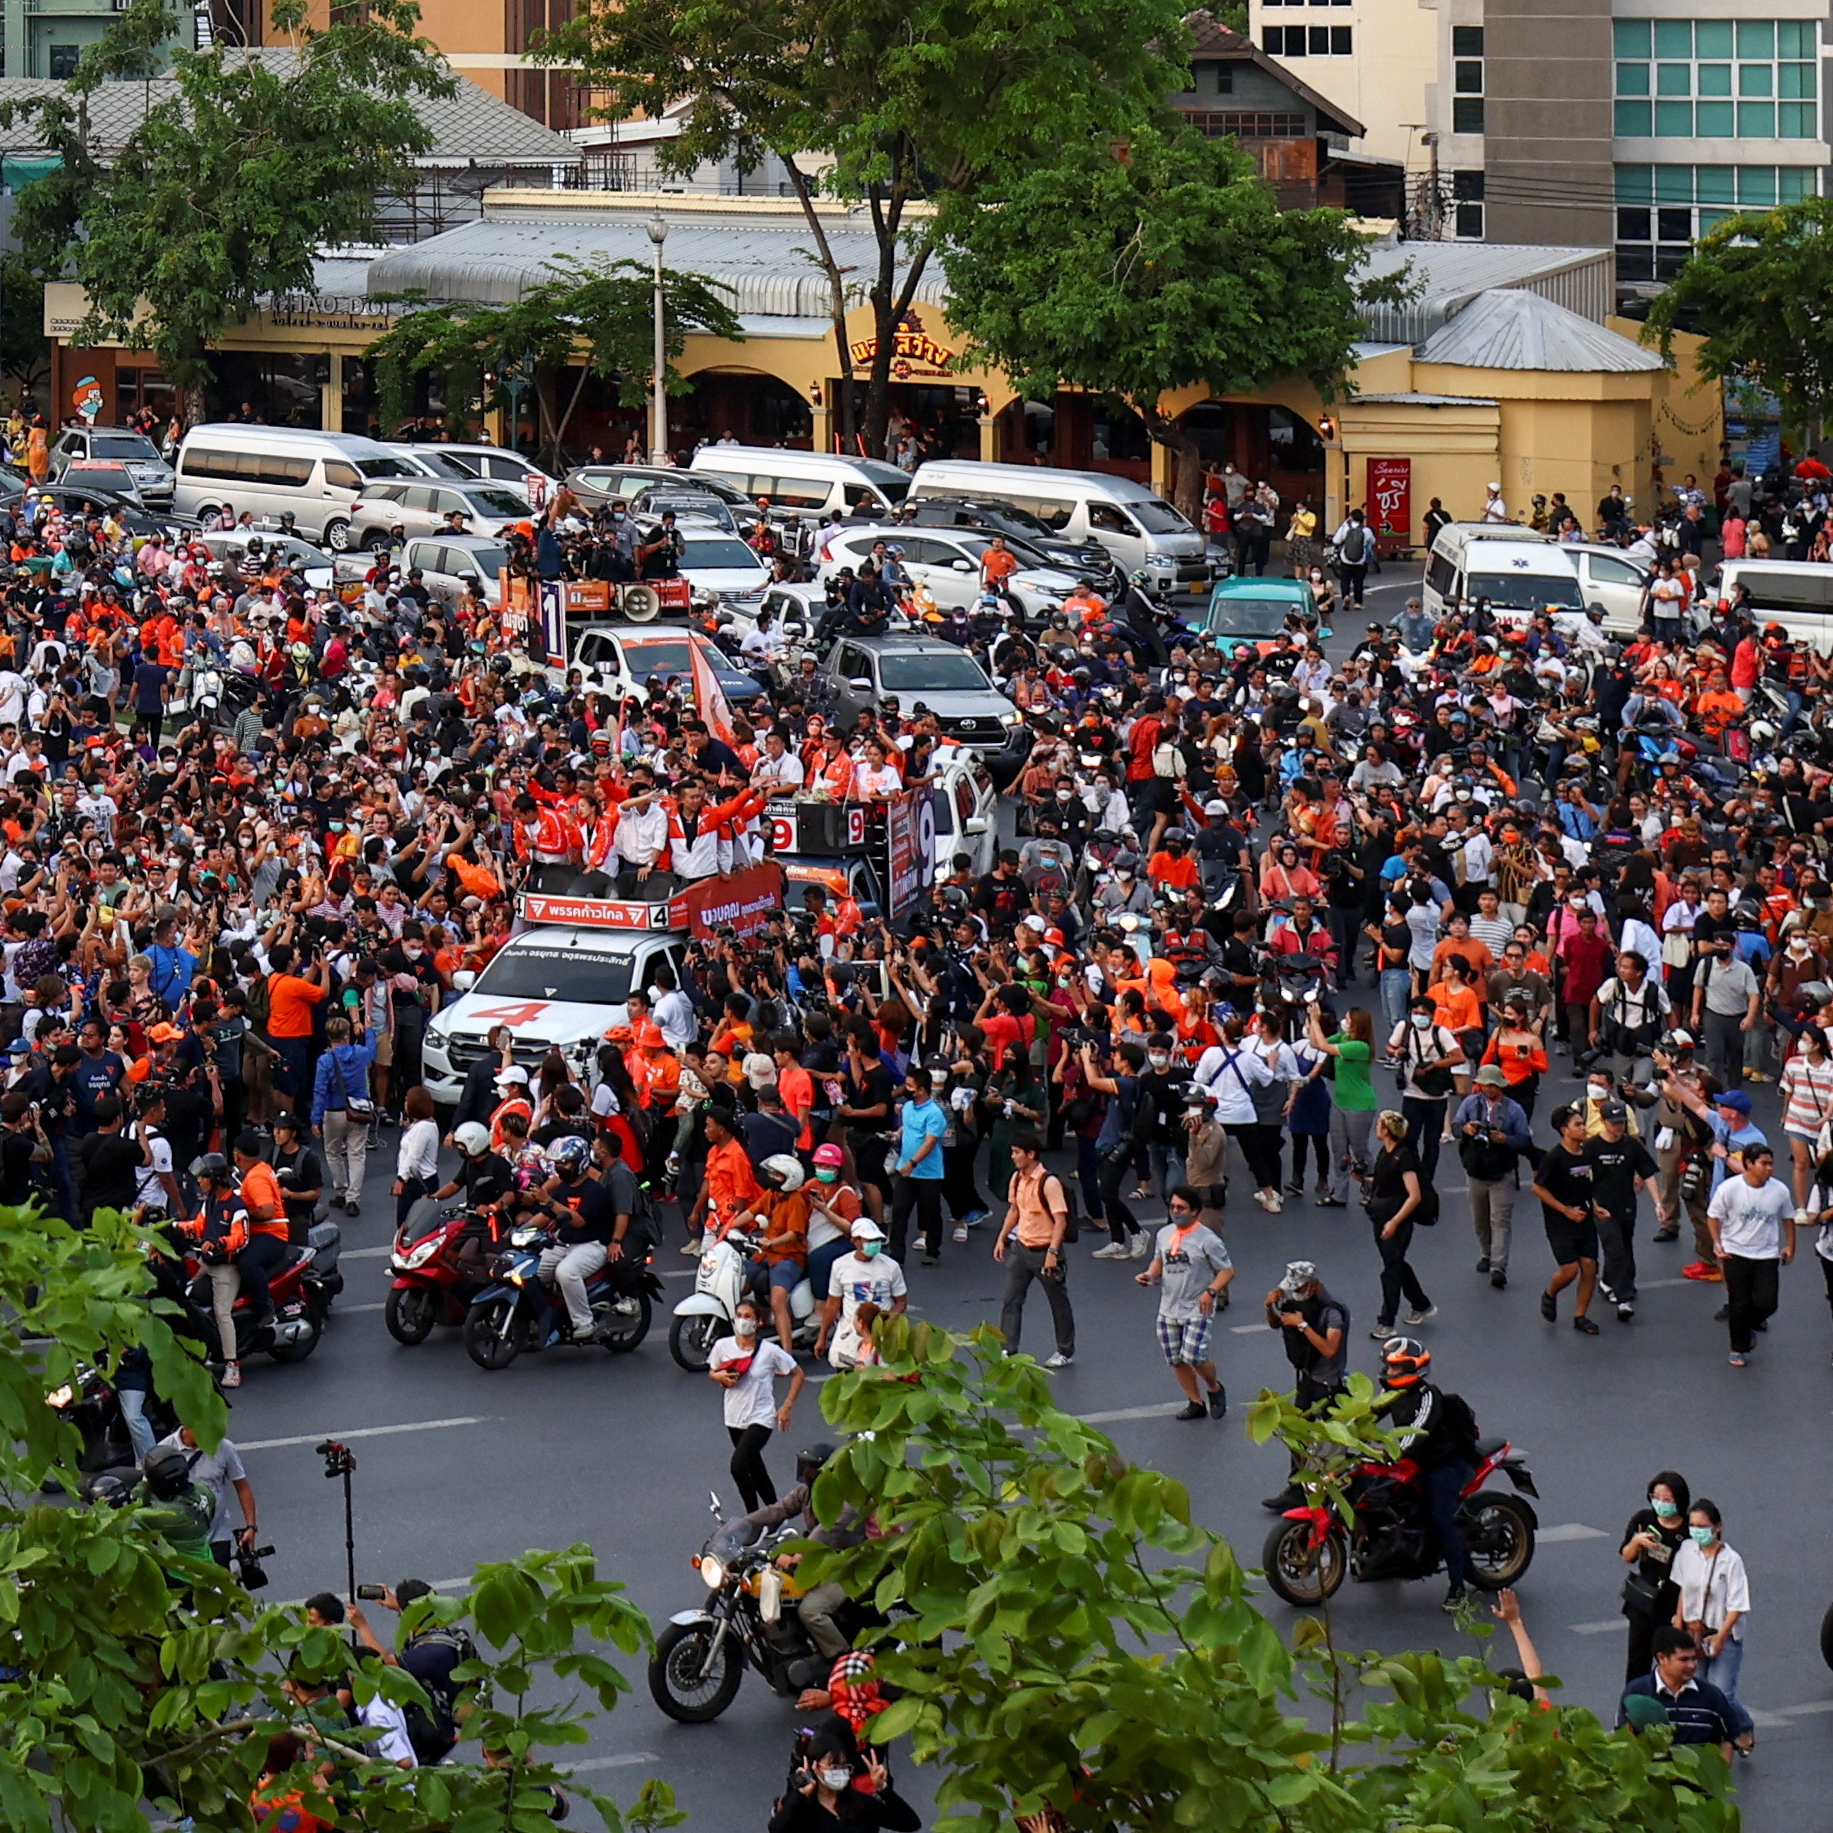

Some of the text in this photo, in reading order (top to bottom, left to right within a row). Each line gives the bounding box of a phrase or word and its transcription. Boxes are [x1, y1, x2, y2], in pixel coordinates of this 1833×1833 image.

[544, 594, 557, 653] 1
[773, 819, 792, 849] 9
[851, 813, 863, 842] 9
[920, 801, 935, 888] 9
[549, 904, 623, 920] พรรคก้าวไกล
[654, 907, 666, 926] 4
[467, 1003, 551, 1027] 4
